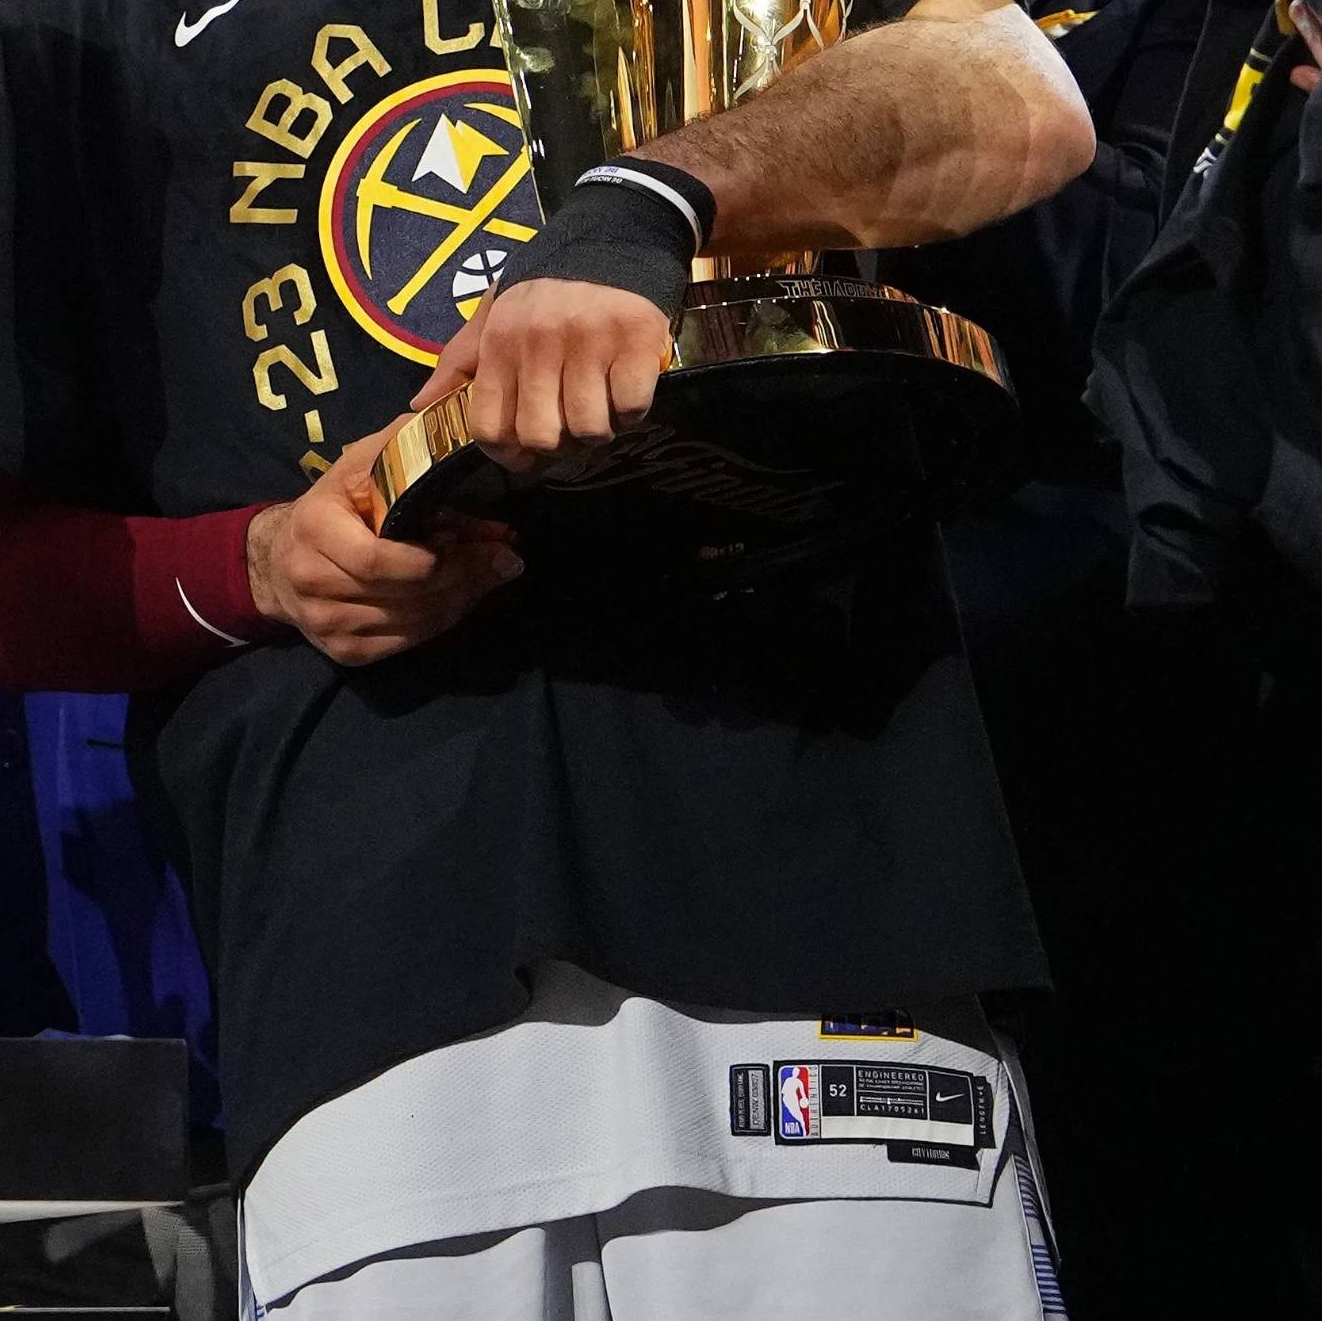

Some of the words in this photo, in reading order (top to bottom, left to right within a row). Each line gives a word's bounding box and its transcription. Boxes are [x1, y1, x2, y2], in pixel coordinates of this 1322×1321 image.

[228, 22, 394, 225] NBA
[858, 1069, 925, 1082] ENGINEERED
[828, 1084, 847, 1098] 52
[784, 1122, 800, 1135] NBA
